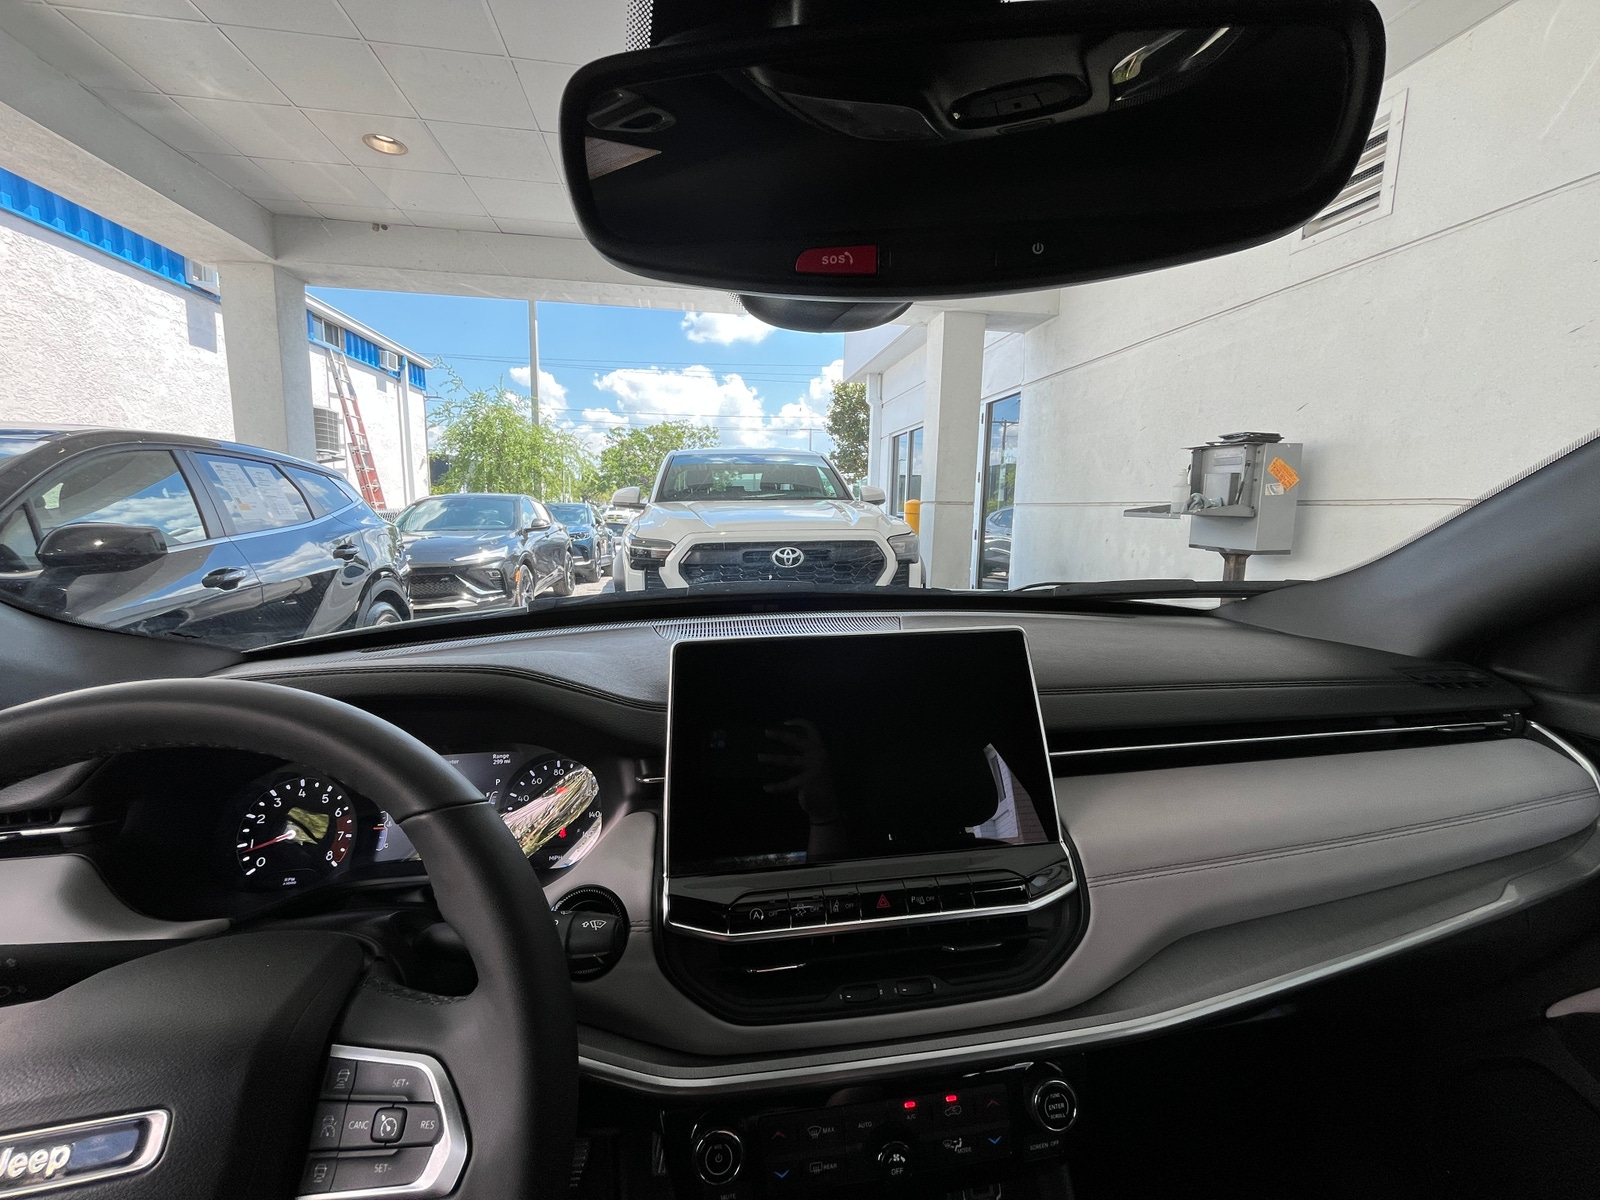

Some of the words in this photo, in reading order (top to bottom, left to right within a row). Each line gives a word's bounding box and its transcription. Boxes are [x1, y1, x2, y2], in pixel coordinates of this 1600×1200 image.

[822, 254, 845, 265] SOS
[553, 768, 564, 776] 80
[531, 777, 543, 785] 60
[298, 788, 306, 797] 4
[273, 797, 282, 807] 3
[321, 793, 330, 803] 5
[334, 807, 342, 817] 6
[256, 813, 266, 824] 2
[337, 831, 345, 841] 7
[325, 850, 334, 861] 8
[256, 856, 266, 867] 0
[391, 1079, 409, 1088] SET+
[1048, 1102, 1065, 1111] ENTER
[348, 1120, 370, 1130] CANC
[420, 1120, 435, 1130] RES
[858, 1121, 872, 1129] AUTO
[1029, 1142, 1049, 1151] SCREEN
[0, 1144, 71, 1179] Jeep
[891, 1167, 904, 1176] OFF
